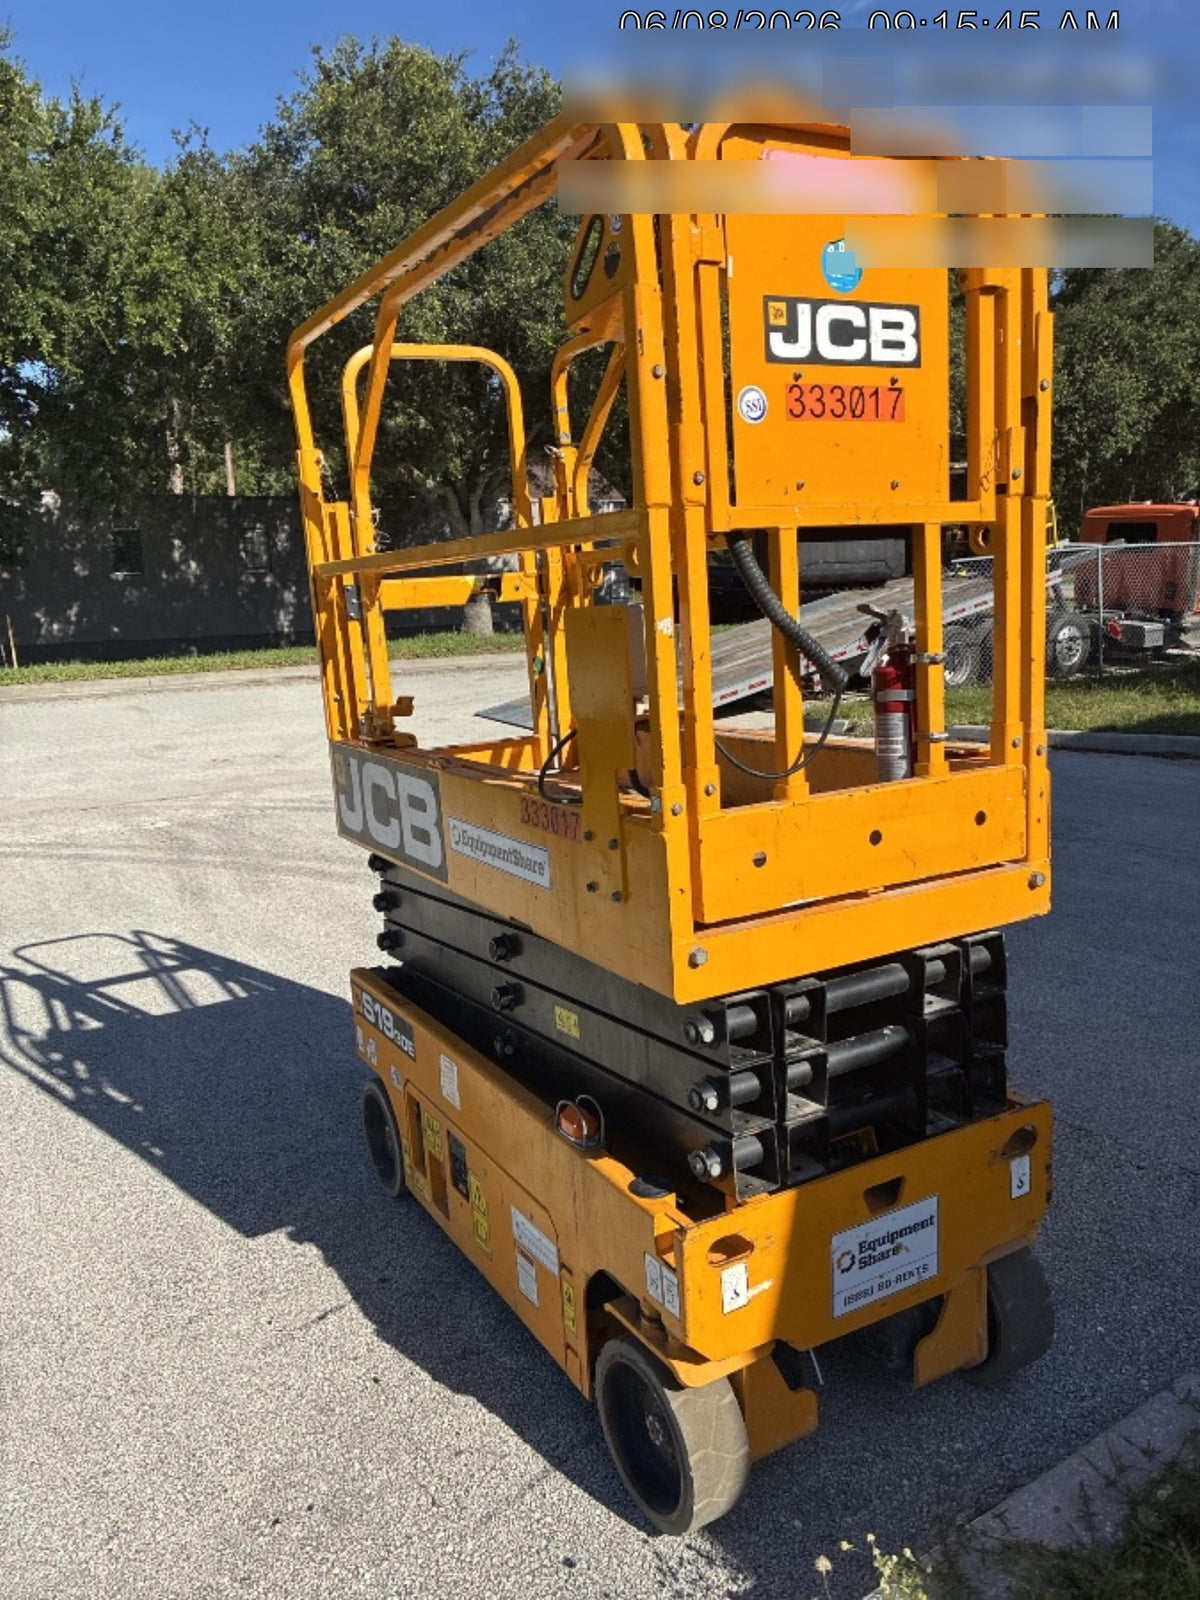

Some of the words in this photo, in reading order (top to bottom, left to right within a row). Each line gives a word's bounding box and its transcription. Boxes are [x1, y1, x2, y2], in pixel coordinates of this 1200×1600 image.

[769, 303, 918, 363] JCB
[787, 384, 904, 420] 333017
[339, 757, 442, 868] JCB
[521, 797, 580, 841] 333017
[461, 829, 545, 877] EquipmentShare
[858, 1214, 935, 1256] Equipment
[858, 1244, 902, 1270] Share
